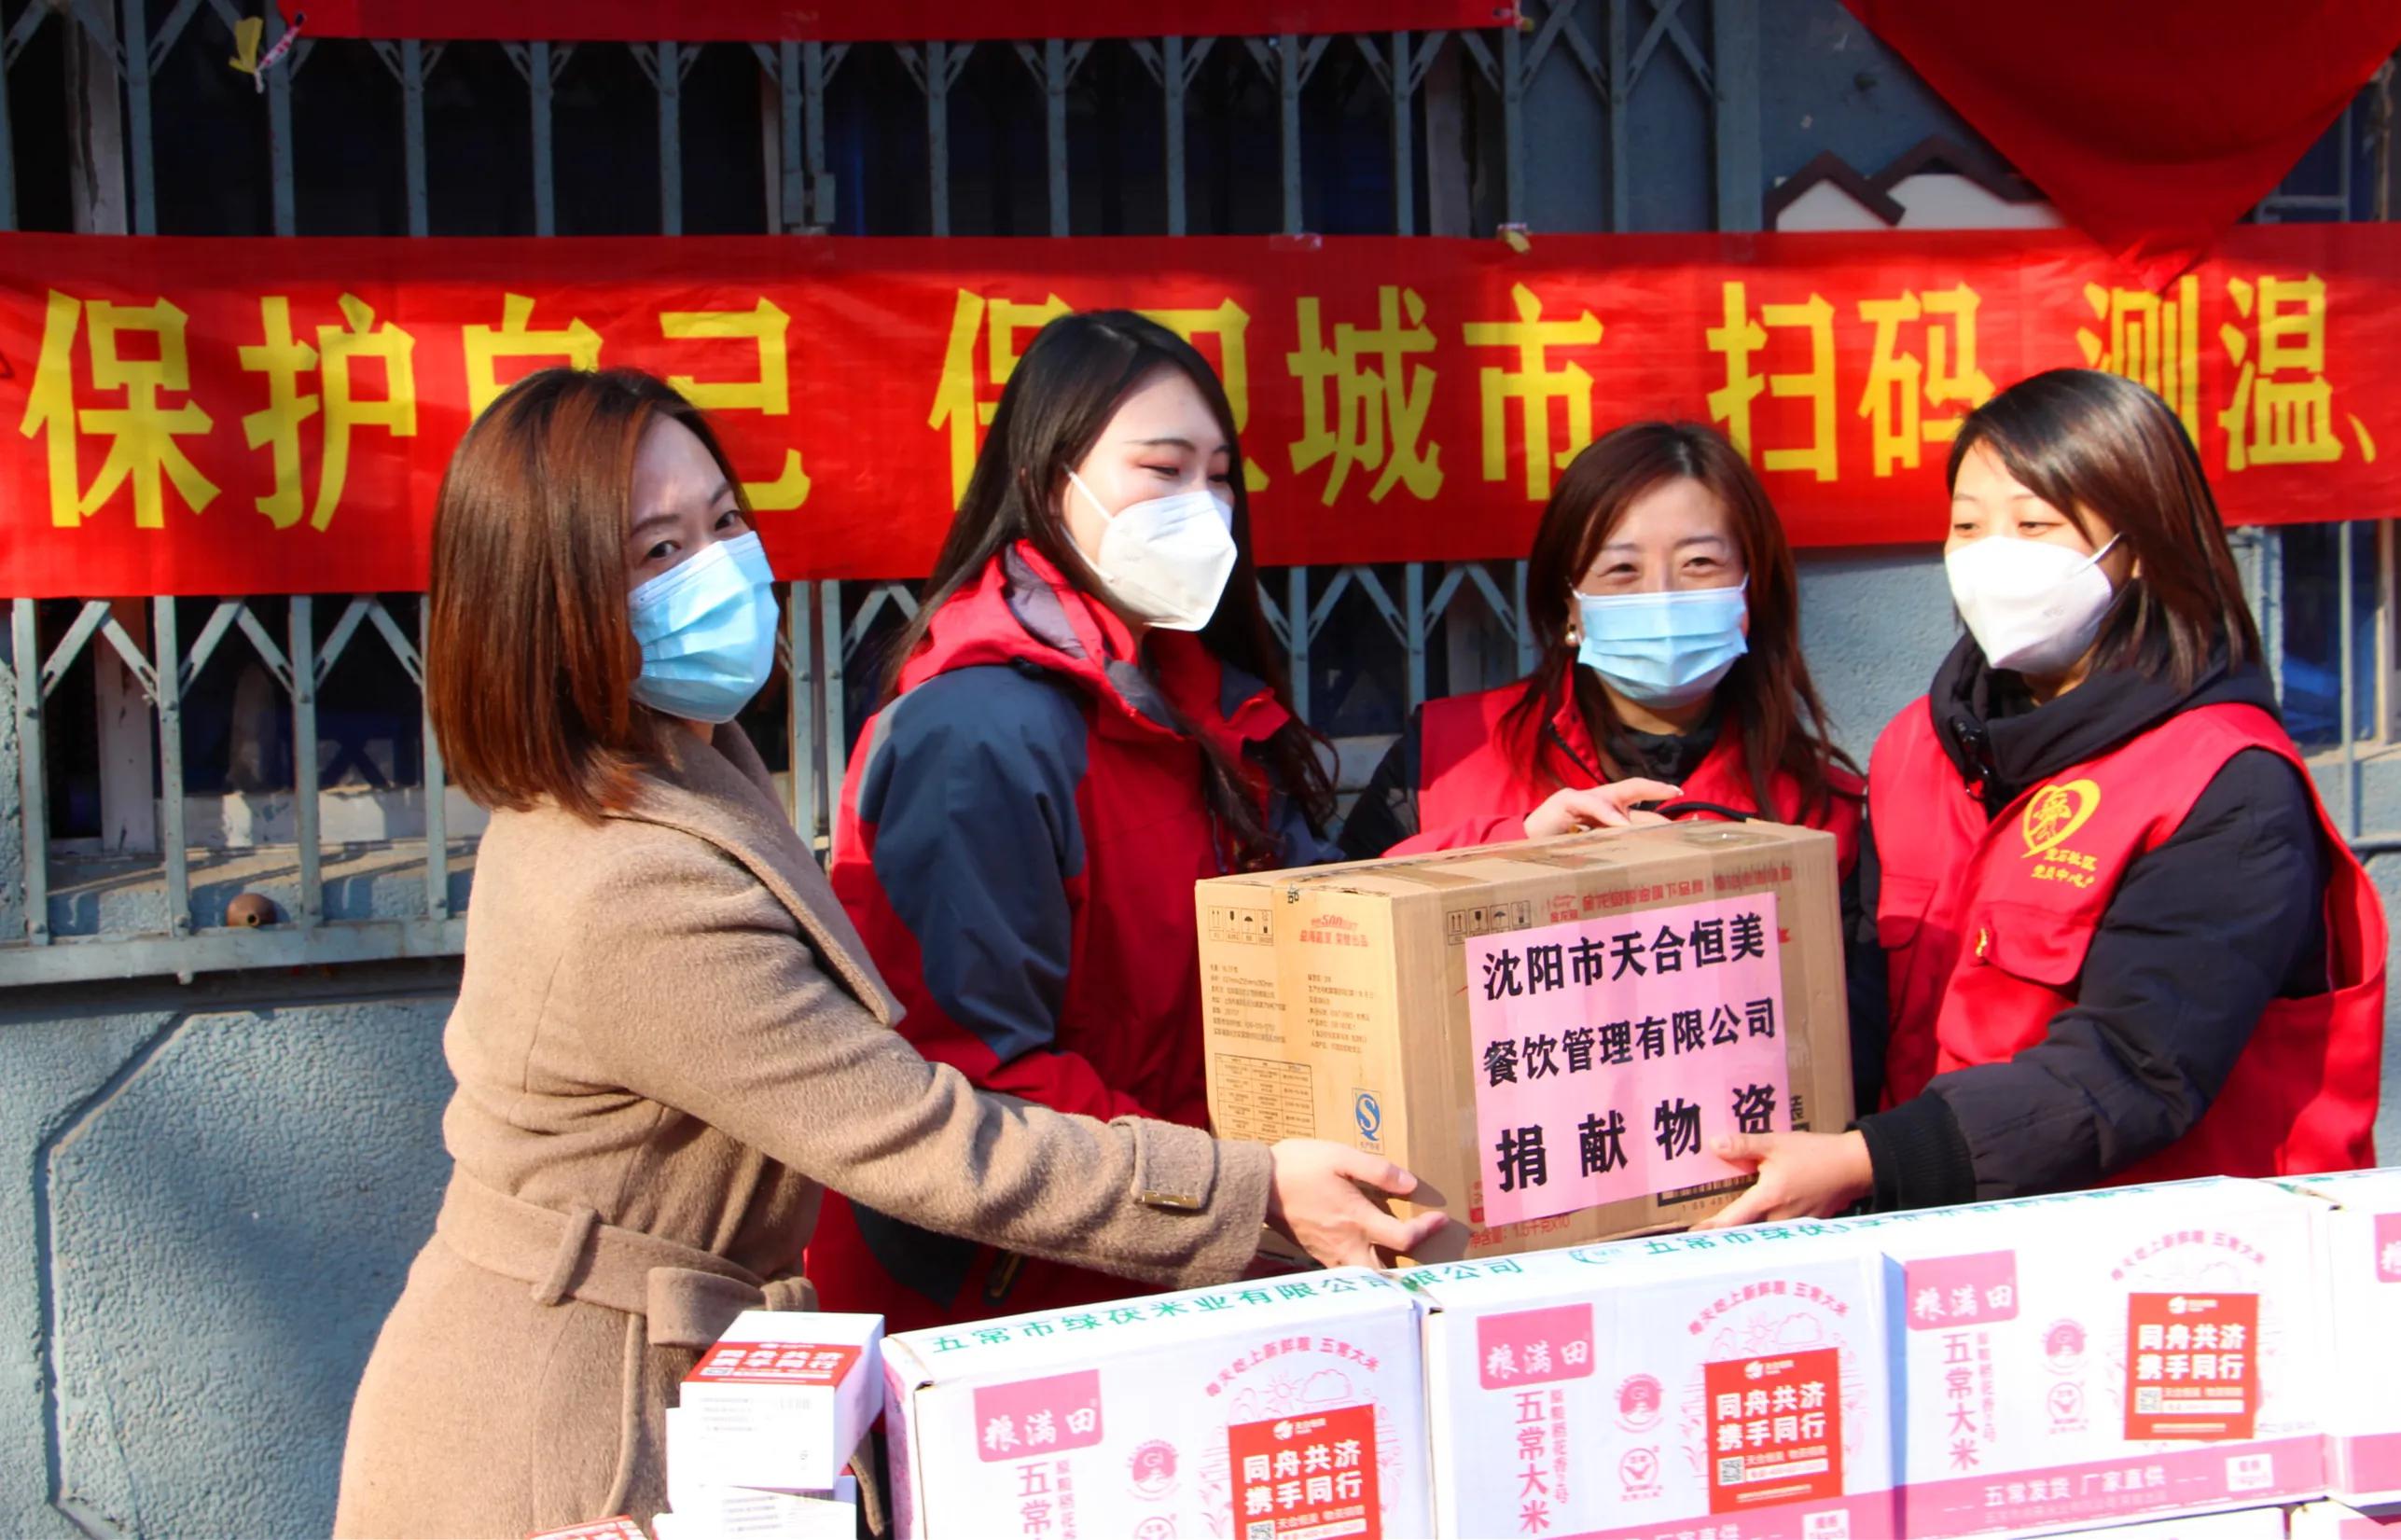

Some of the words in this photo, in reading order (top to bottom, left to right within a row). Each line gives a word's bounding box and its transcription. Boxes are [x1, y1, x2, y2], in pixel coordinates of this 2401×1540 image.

[1706, 281, 1997, 483] 扫码
[1482, 911, 1766, 1002] 沈阳市天合恒美
[1483, 997, 1777, 1089] 餐饮管理有限公司
[2138, 1323, 2246, 1351] 同舟共济
[2136, 1353, 2245, 1381] 携手同行
[1715, 1380, 1826, 1421] 同舟共济
[1942, 1331, 1980, 1472] 五常大米
[1716, 1411, 1826, 1451] 携手同行
[1242, 1437, 1363, 1485] 同舟共济
[1513, 1390, 1551, 1535] 五常大米
[1243, 1470, 1364, 1516] 携手同行
